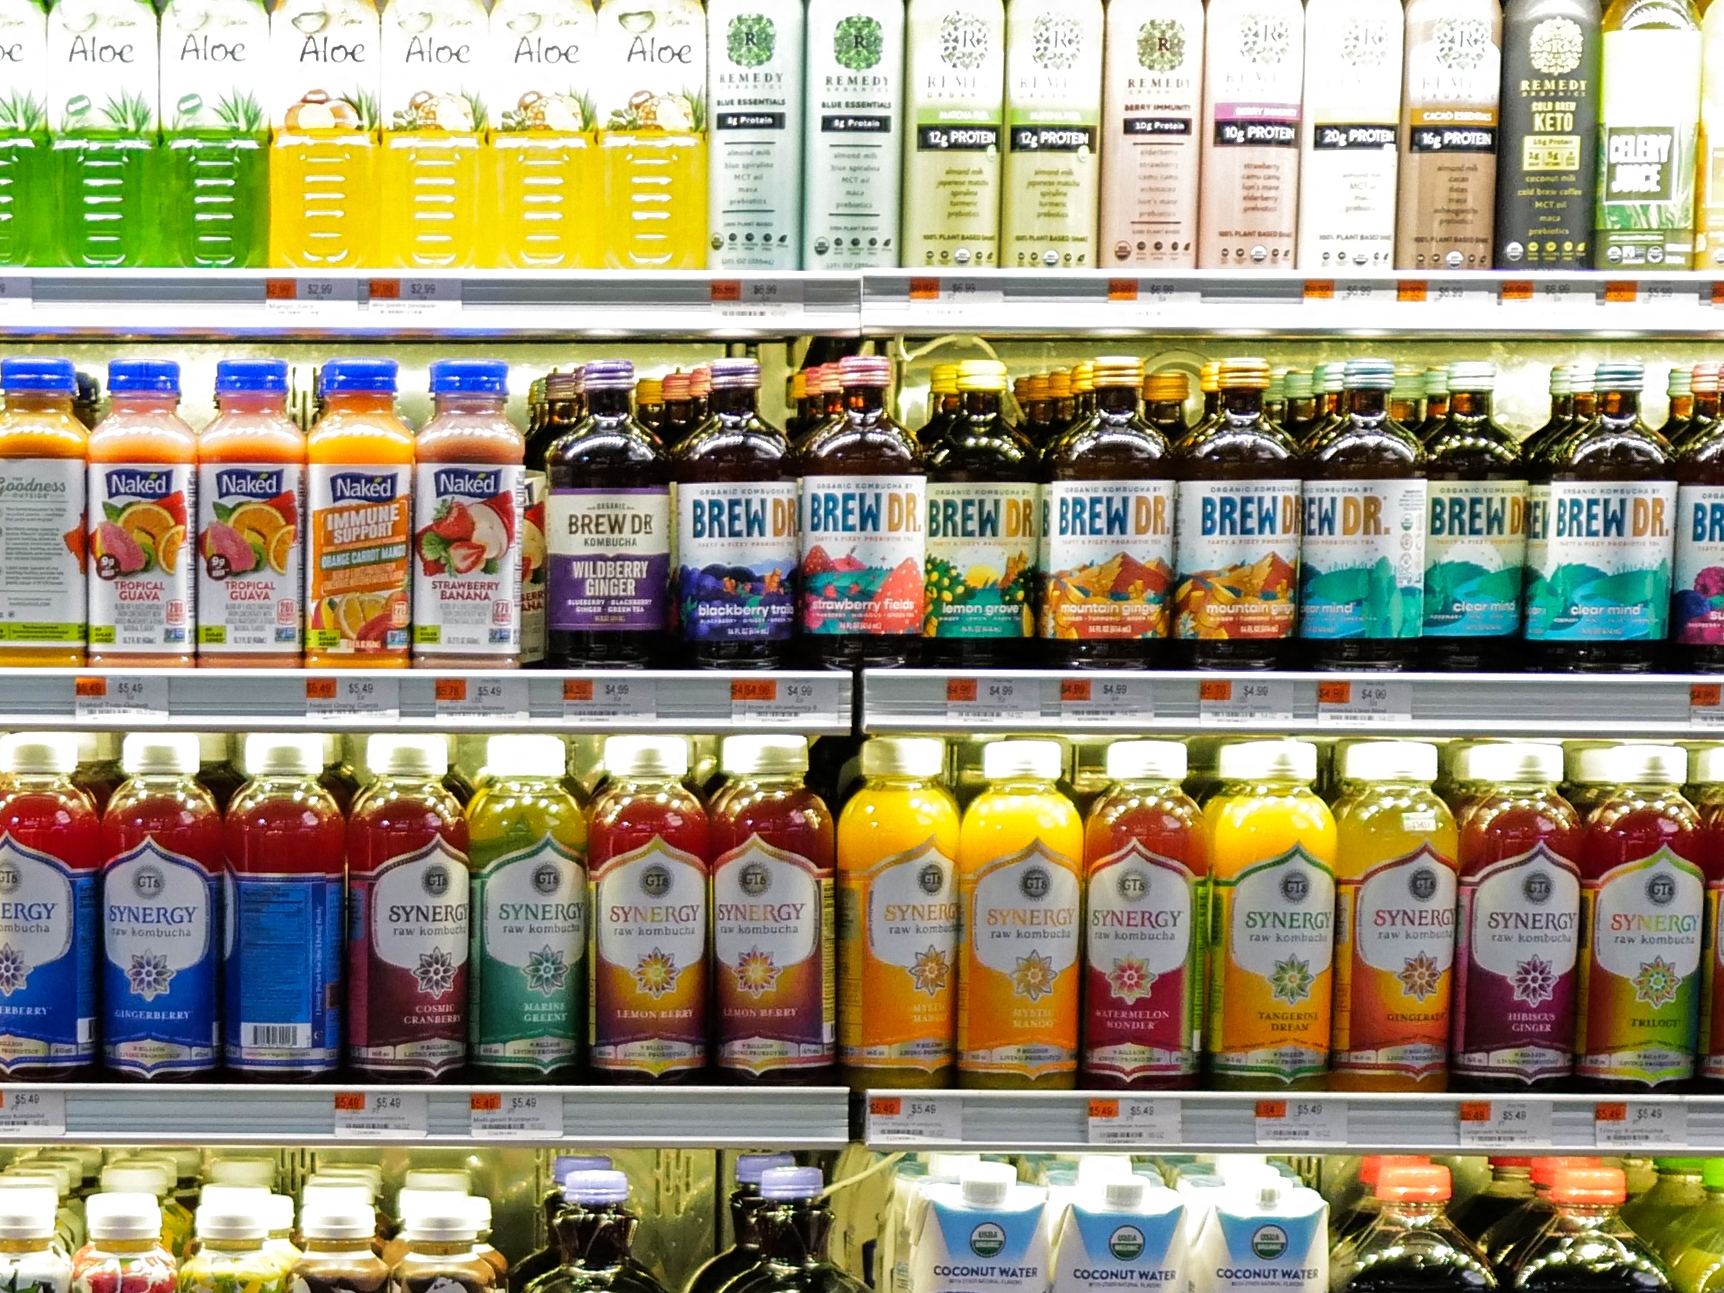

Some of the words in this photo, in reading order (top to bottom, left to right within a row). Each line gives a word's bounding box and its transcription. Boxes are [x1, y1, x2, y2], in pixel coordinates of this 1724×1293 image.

[69, 36, 134, 63] Aloe
[181, 36, 246, 62] Aloe
[300, 37, 366, 63] Aloe
[406, 37, 471, 63] Aloe
[515, 37, 580, 64] Aloe
[627, 37, 693, 64] Aloe
[1533, 113, 1574, 131] KETO
[1040, 131, 1088, 145] PROTEIN
[111, 473, 167, 493] Naked
[336, 478, 393, 498] Naked
[440, 473, 497, 495] Naked
[327, 509, 399, 529] IMMUNE
[693, 499, 767, 540] BREW
[810, 493, 880, 533] BREW
[1059, 496, 1129, 536] BREW
[1557, 498, 1627, 537] BREW
[333, 523, 393, 543] SUPPORT
[584, 538, 637, 547] KOMBUCHA
[572, 561, 649, 580] WILDBERRY
[114, 581, 165, 592] TROPICAL
[119, 590, 160, 601] GUAVA
[431, 580, 500, 592] STRAWBERRY
[585, 579, 636, 597] GINGER
[440, 590, 491, 602] BANANA
[812, 600, 880, 613] strawberry
[884, 598, 915, 610] fields
[698, 603, 757, 619] blackberry
[942, 602, 982, 614] lemon
[985, 605, 1019, 618] grove
[1061, 602, 1119, 615] mountain
[1570, 604, 1602, 616] clear
[1604, 604, 1641, 615] mind
[109, 905, 196, 925] SYNERGY
[499, 903, 583, 922] SYNERGY
[610, 905, 700, 923] SYNERGY
[718, 903, 806, 921] SYNERGY
[986, 908, 1077, 927] SYNERGY
[1092, 910, 1182, 929] SYNERGY
[1245, 911, 1332, 930] SYNERGY
[1488, 912, 1577, 930] SYNERGY
[1610, 914, 1699, 932] SYNERGY
[934, 1266, 995, 1278] COCONUT
[997, 1267, 1038, 1278] WATER
[1073, 1268, 1132, 1281] COCONUT
[1135, 1270, 1176, 1281] WATER
[1216, 1268, 1277, 1279] COCONUT
[1279, 1268, 1319, 1280] WATER
